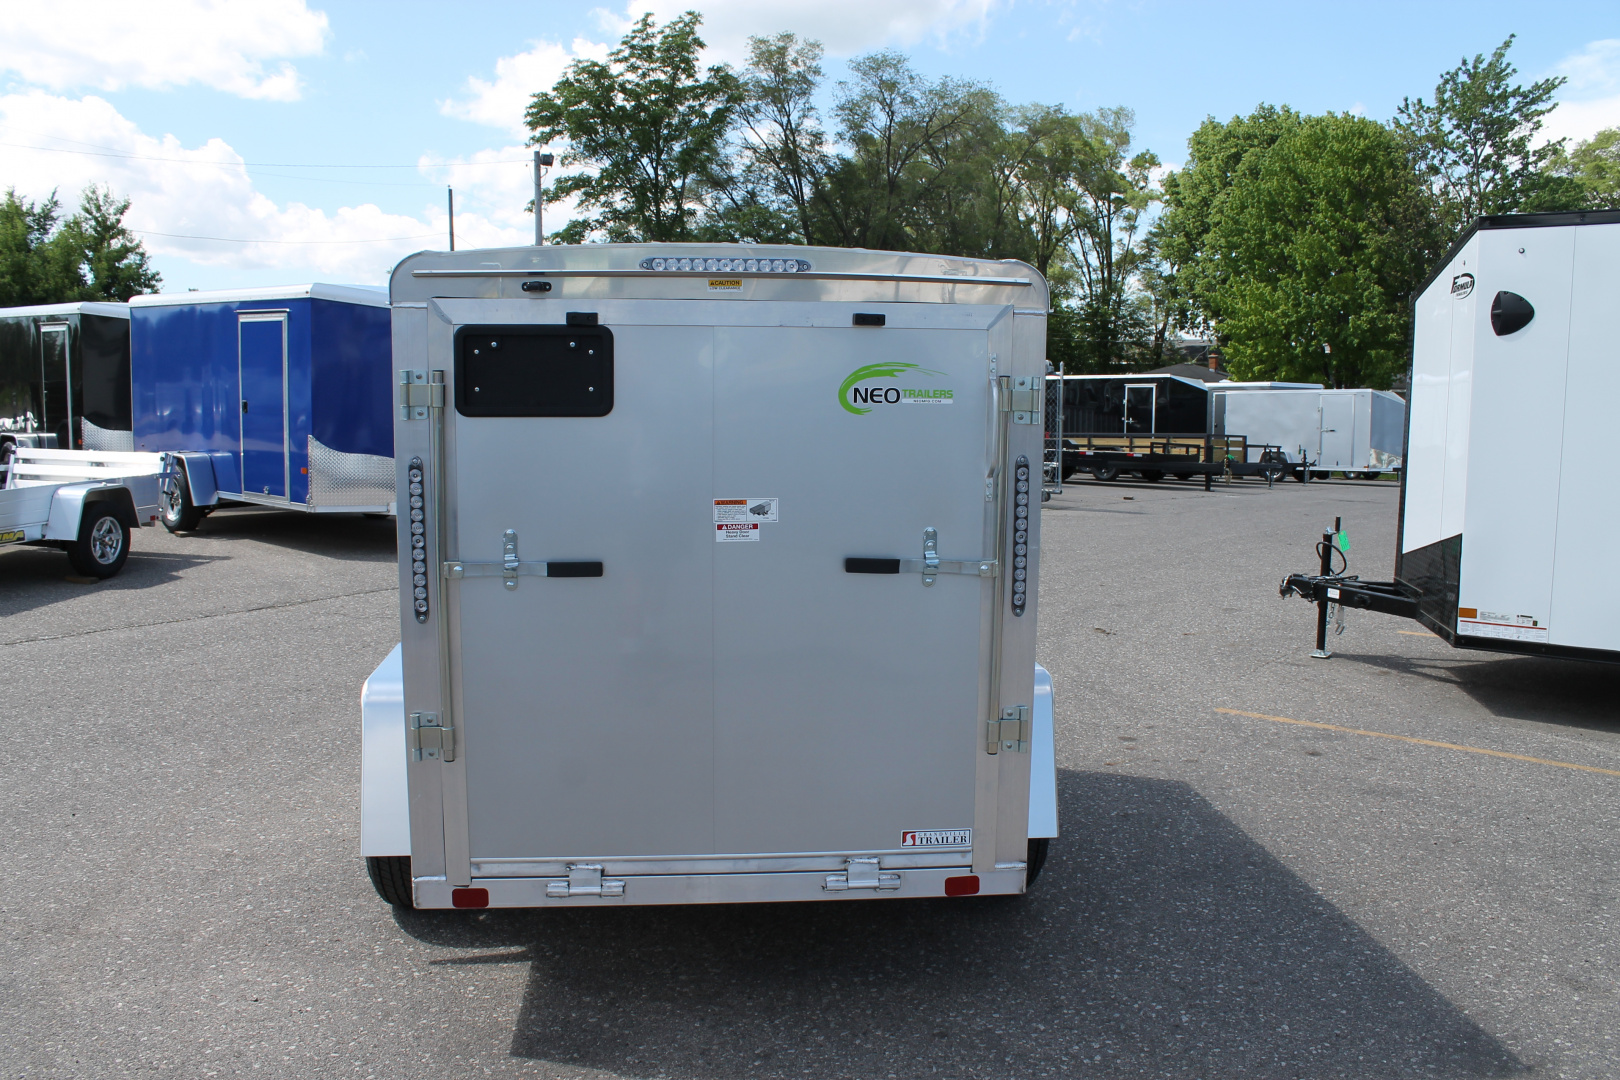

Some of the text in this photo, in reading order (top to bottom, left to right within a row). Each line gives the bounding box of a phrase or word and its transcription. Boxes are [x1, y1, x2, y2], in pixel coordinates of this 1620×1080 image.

[853, 387, 953, 404] NEO TRAILERS
[918, 836, 968, 845] TRAILER
